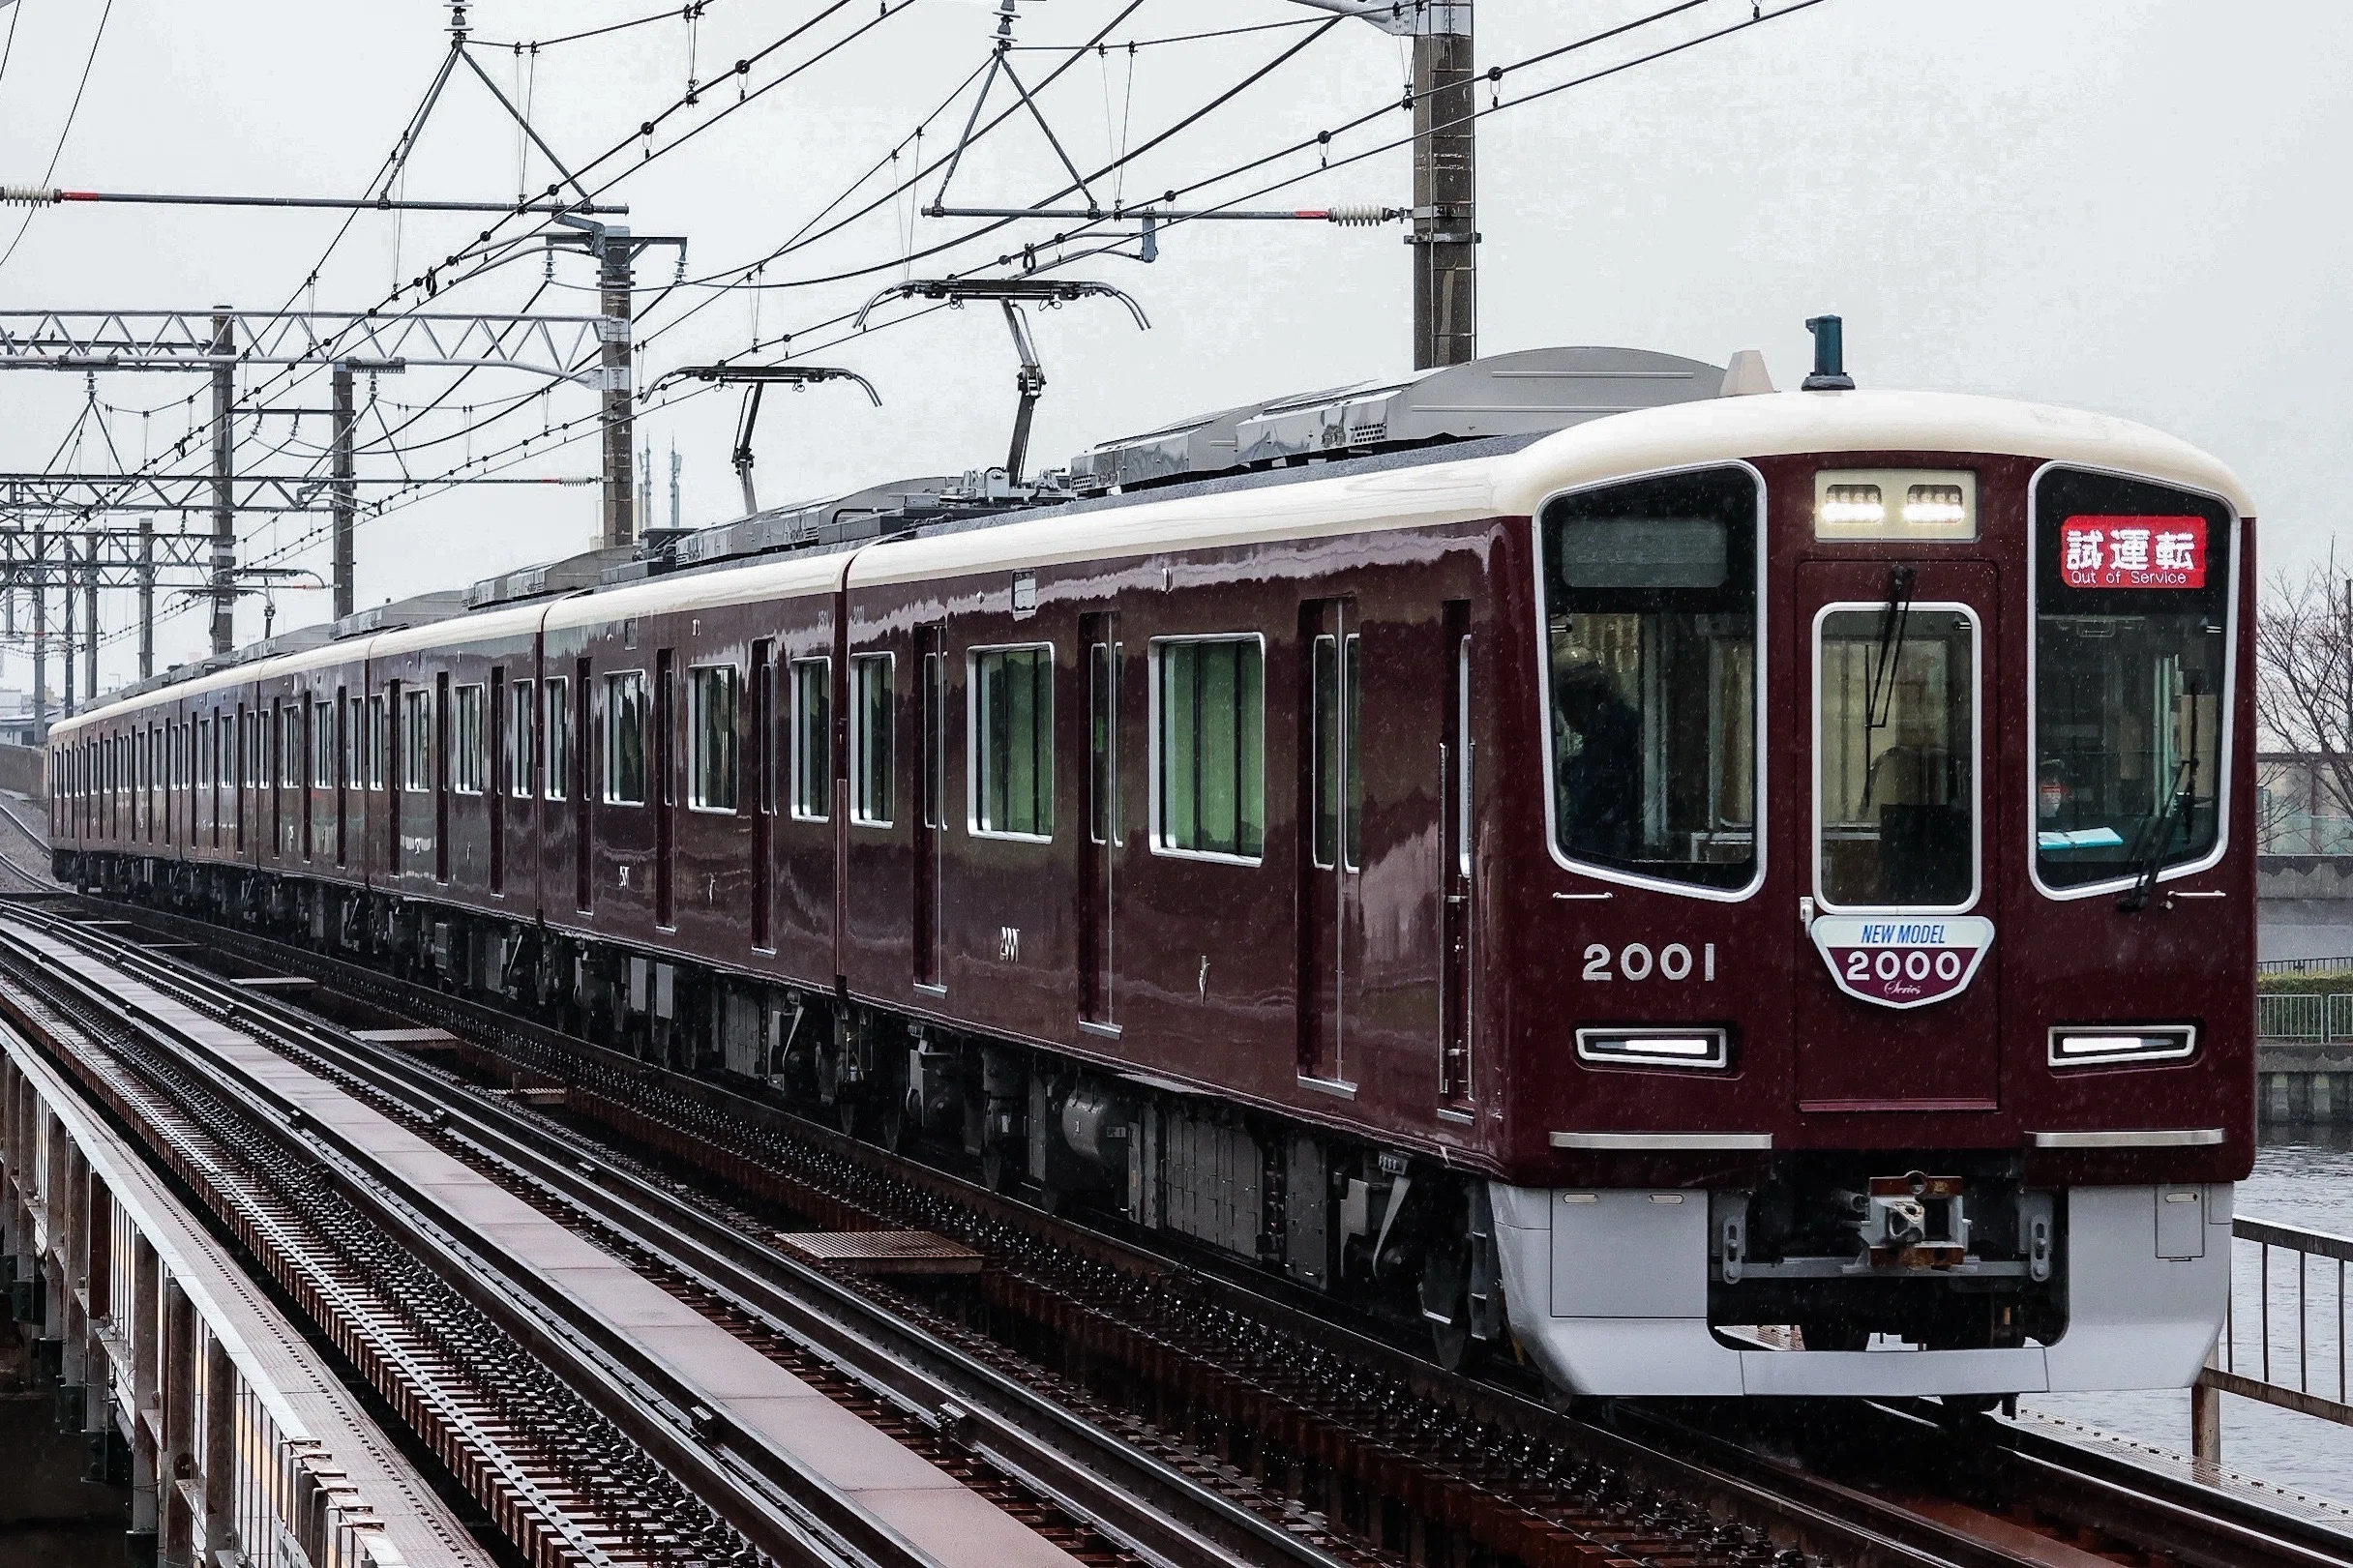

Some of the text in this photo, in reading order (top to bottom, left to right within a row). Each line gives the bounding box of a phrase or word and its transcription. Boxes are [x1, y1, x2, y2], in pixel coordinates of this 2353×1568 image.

[2066, 529, 2195, 570] 試運転
[2071, 570, 2187, 584] Out of Service
[1861, 925, 1946, 944] NEW MODEL
[1582, 942, 1714, 981] 2001
[1846, 950, 1961, 981] 2000
[1884, 979, 1921, 995] Series
